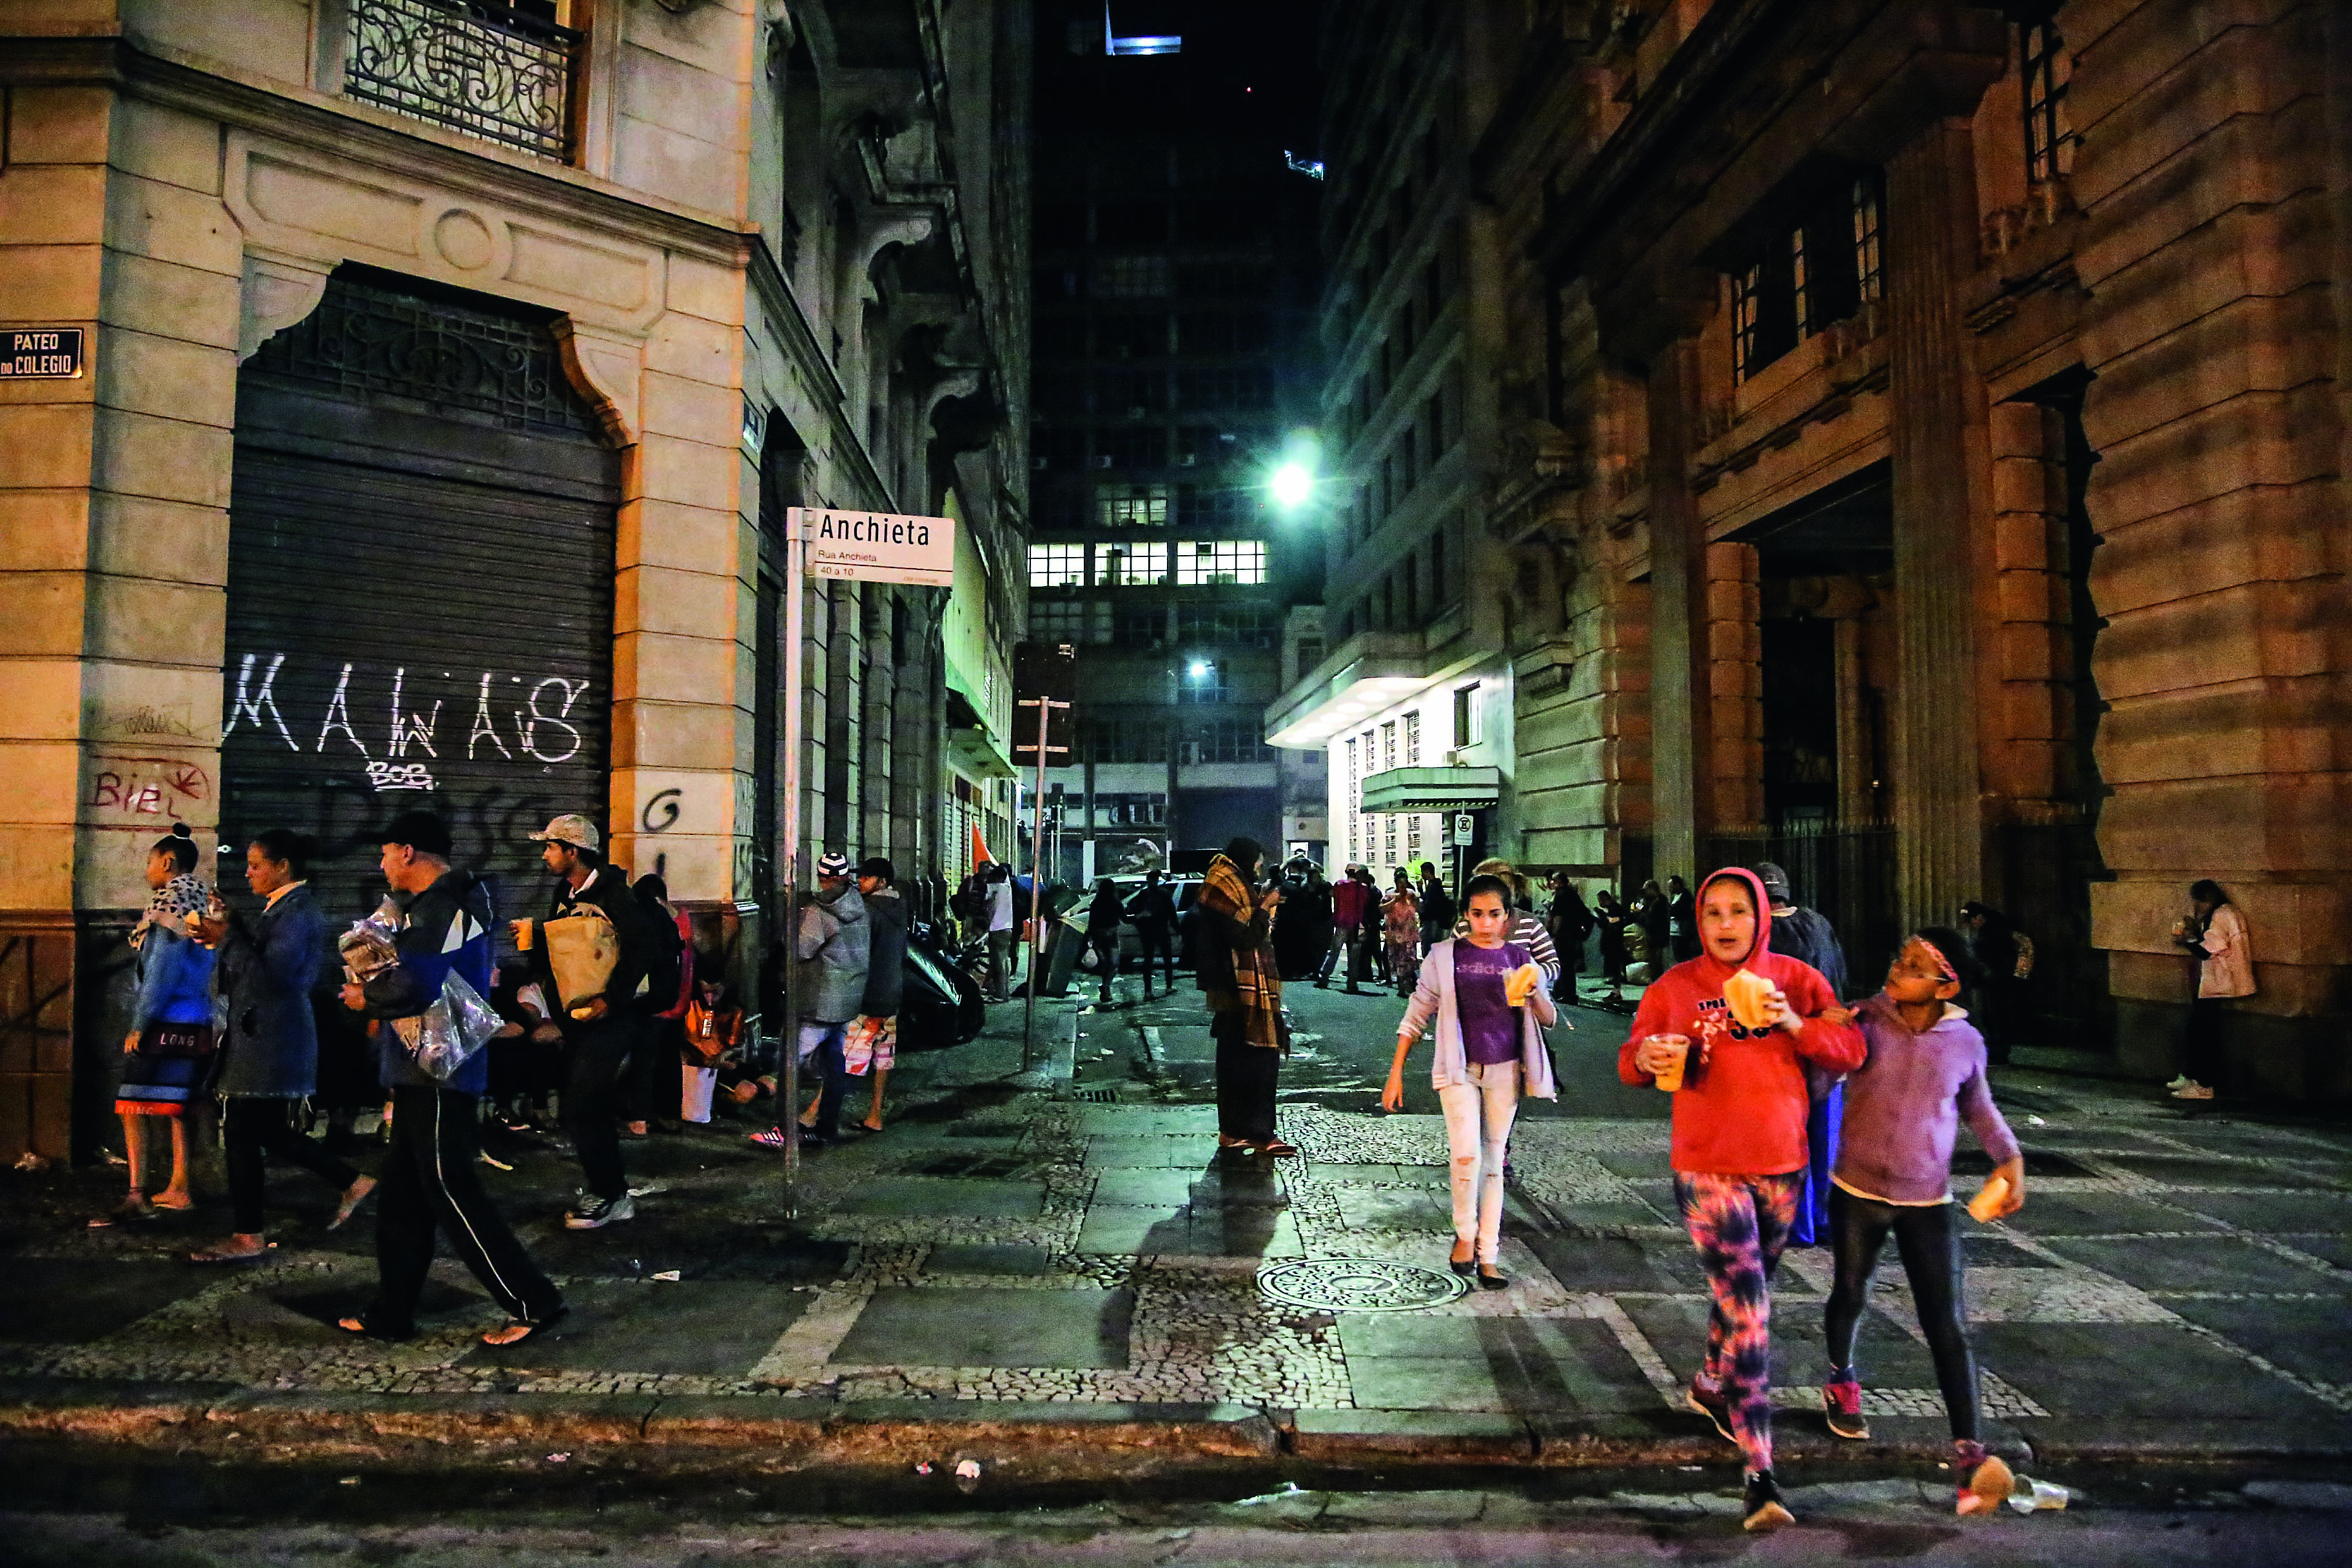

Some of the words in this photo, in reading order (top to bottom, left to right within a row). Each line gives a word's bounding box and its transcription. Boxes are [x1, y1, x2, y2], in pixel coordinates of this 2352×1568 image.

[14, 333, 59, 351] PATEO
[15, 355, 72, 374] COLEGIO
[819, 514, 929, 546] Anchieta
[818, 549, 836, 559] Rua
[839, 552, 877, 562] Anchieta
[843, 568, 854, 576] 10
